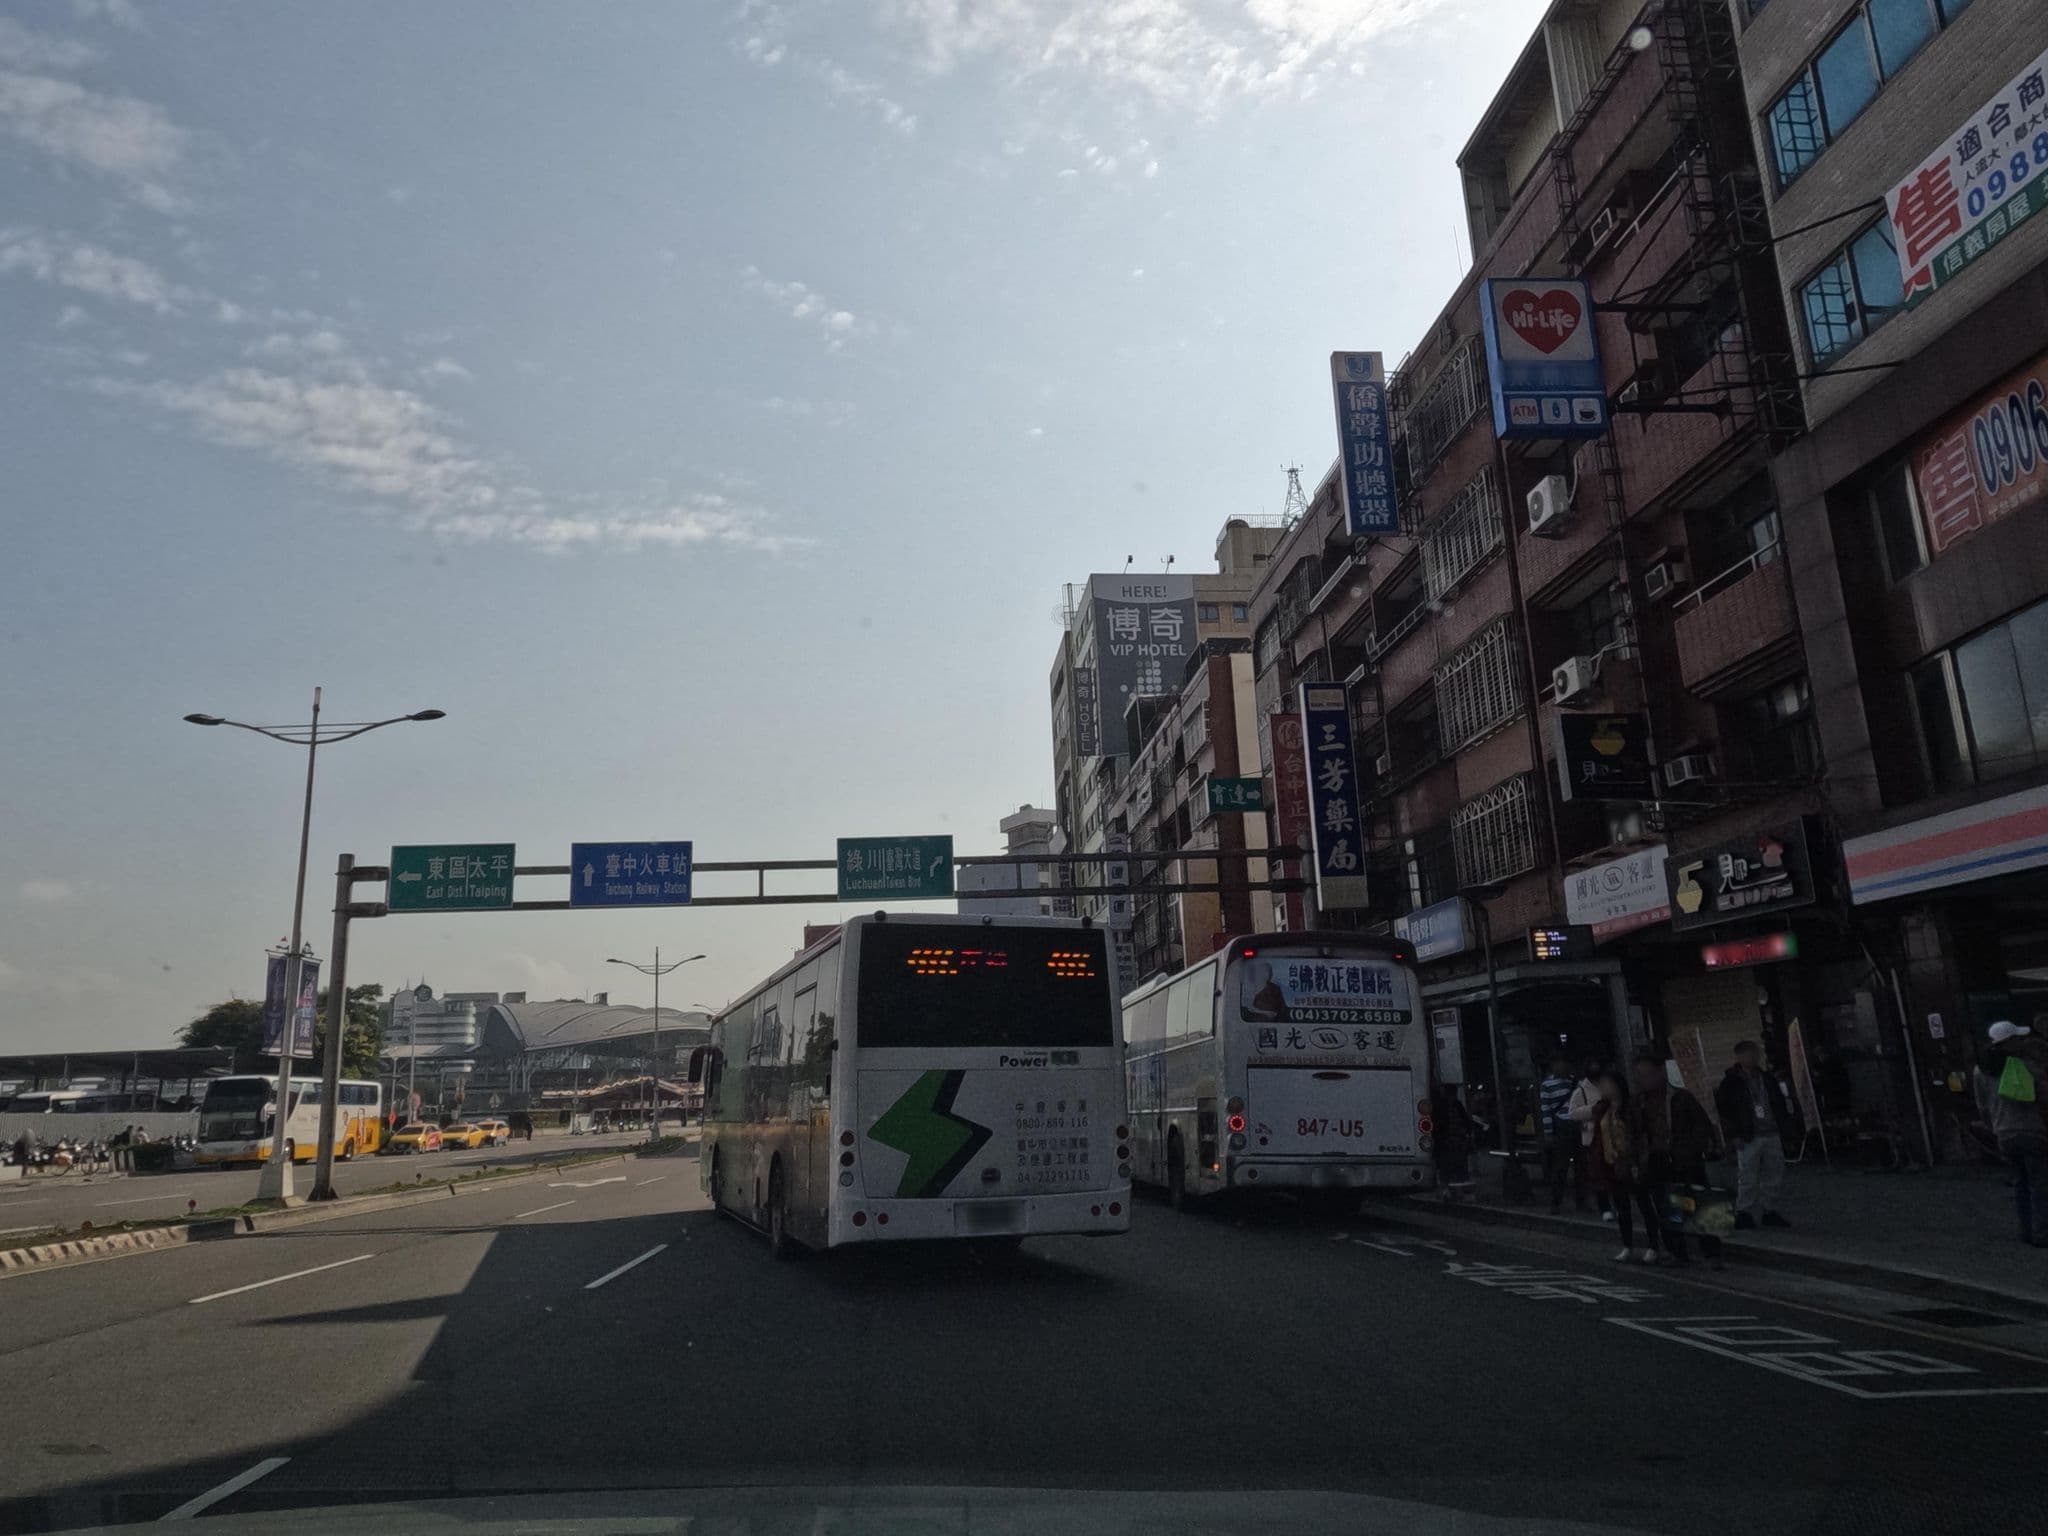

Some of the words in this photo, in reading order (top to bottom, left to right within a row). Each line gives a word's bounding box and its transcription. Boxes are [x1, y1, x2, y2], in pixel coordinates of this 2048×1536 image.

[1894, 155, 1962, 268] 售
[1942, 192, 2031, 276] 信義房屋
[1512, 302, 1576, 337] Hi-Life
[1513, 405, 1538, 418] ATM
[1347, 385, 1391, 527] 僑聲助聽器
[1919, 433, 1983, 553] 售
[1121, 585, 1168, 599] HERE!
[1106, 606, 1185, 642] 博奇
[1110, 644, 1135, 657] VIP
[1138, 644, 1188, 657] HOTEL
[1079, 703, 1092, 752] HOTEL
[1316, 722, 1358, 872] 三芳藥局
[427, 856, 467, 880] 東區
[469, 854, 509, 880] 太平
[604, 853, 689, 878] 臺中火車站
[470, 885, 507, 900] Taiping
[1289, 965, 1299, 991] 台中
[1258, 1027, 1306, 1050] 國光
[1353, 1029, 1397, 1050] 客運
[1000, 1055, 1048, 1067] Power
[1298, 1118, 1364, 1137] 847-U5
